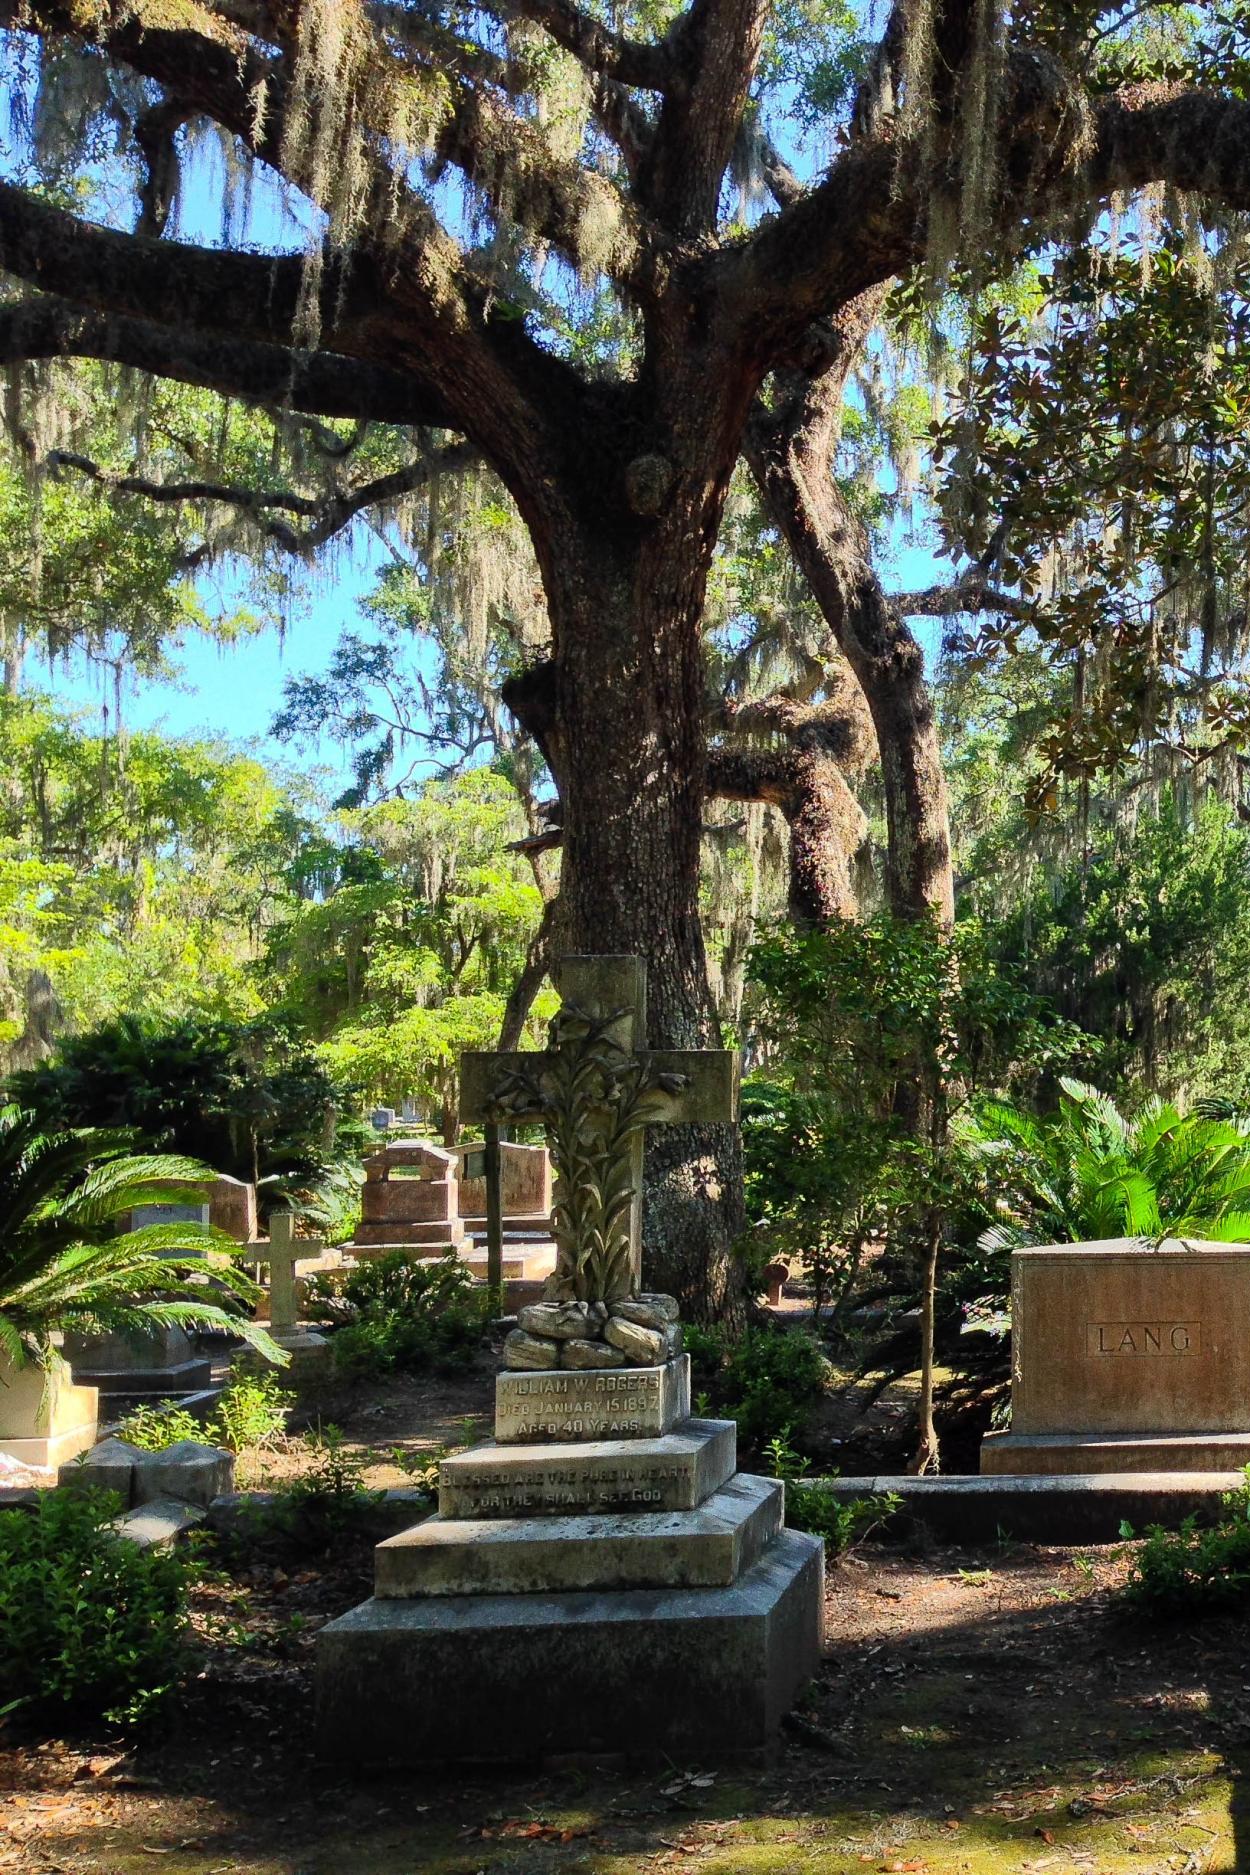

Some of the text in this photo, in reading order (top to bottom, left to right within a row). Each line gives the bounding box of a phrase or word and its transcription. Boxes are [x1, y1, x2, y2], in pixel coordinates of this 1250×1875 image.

[1098, 1326, 1189, 1352] LANG
[501, 1378, 568, 1395] WILLIAM
[596, 1375, 659, 1391] ROGERS
[563, 1419, 584, 1434] 40
[632, 1487, 662, 1502] GOD
